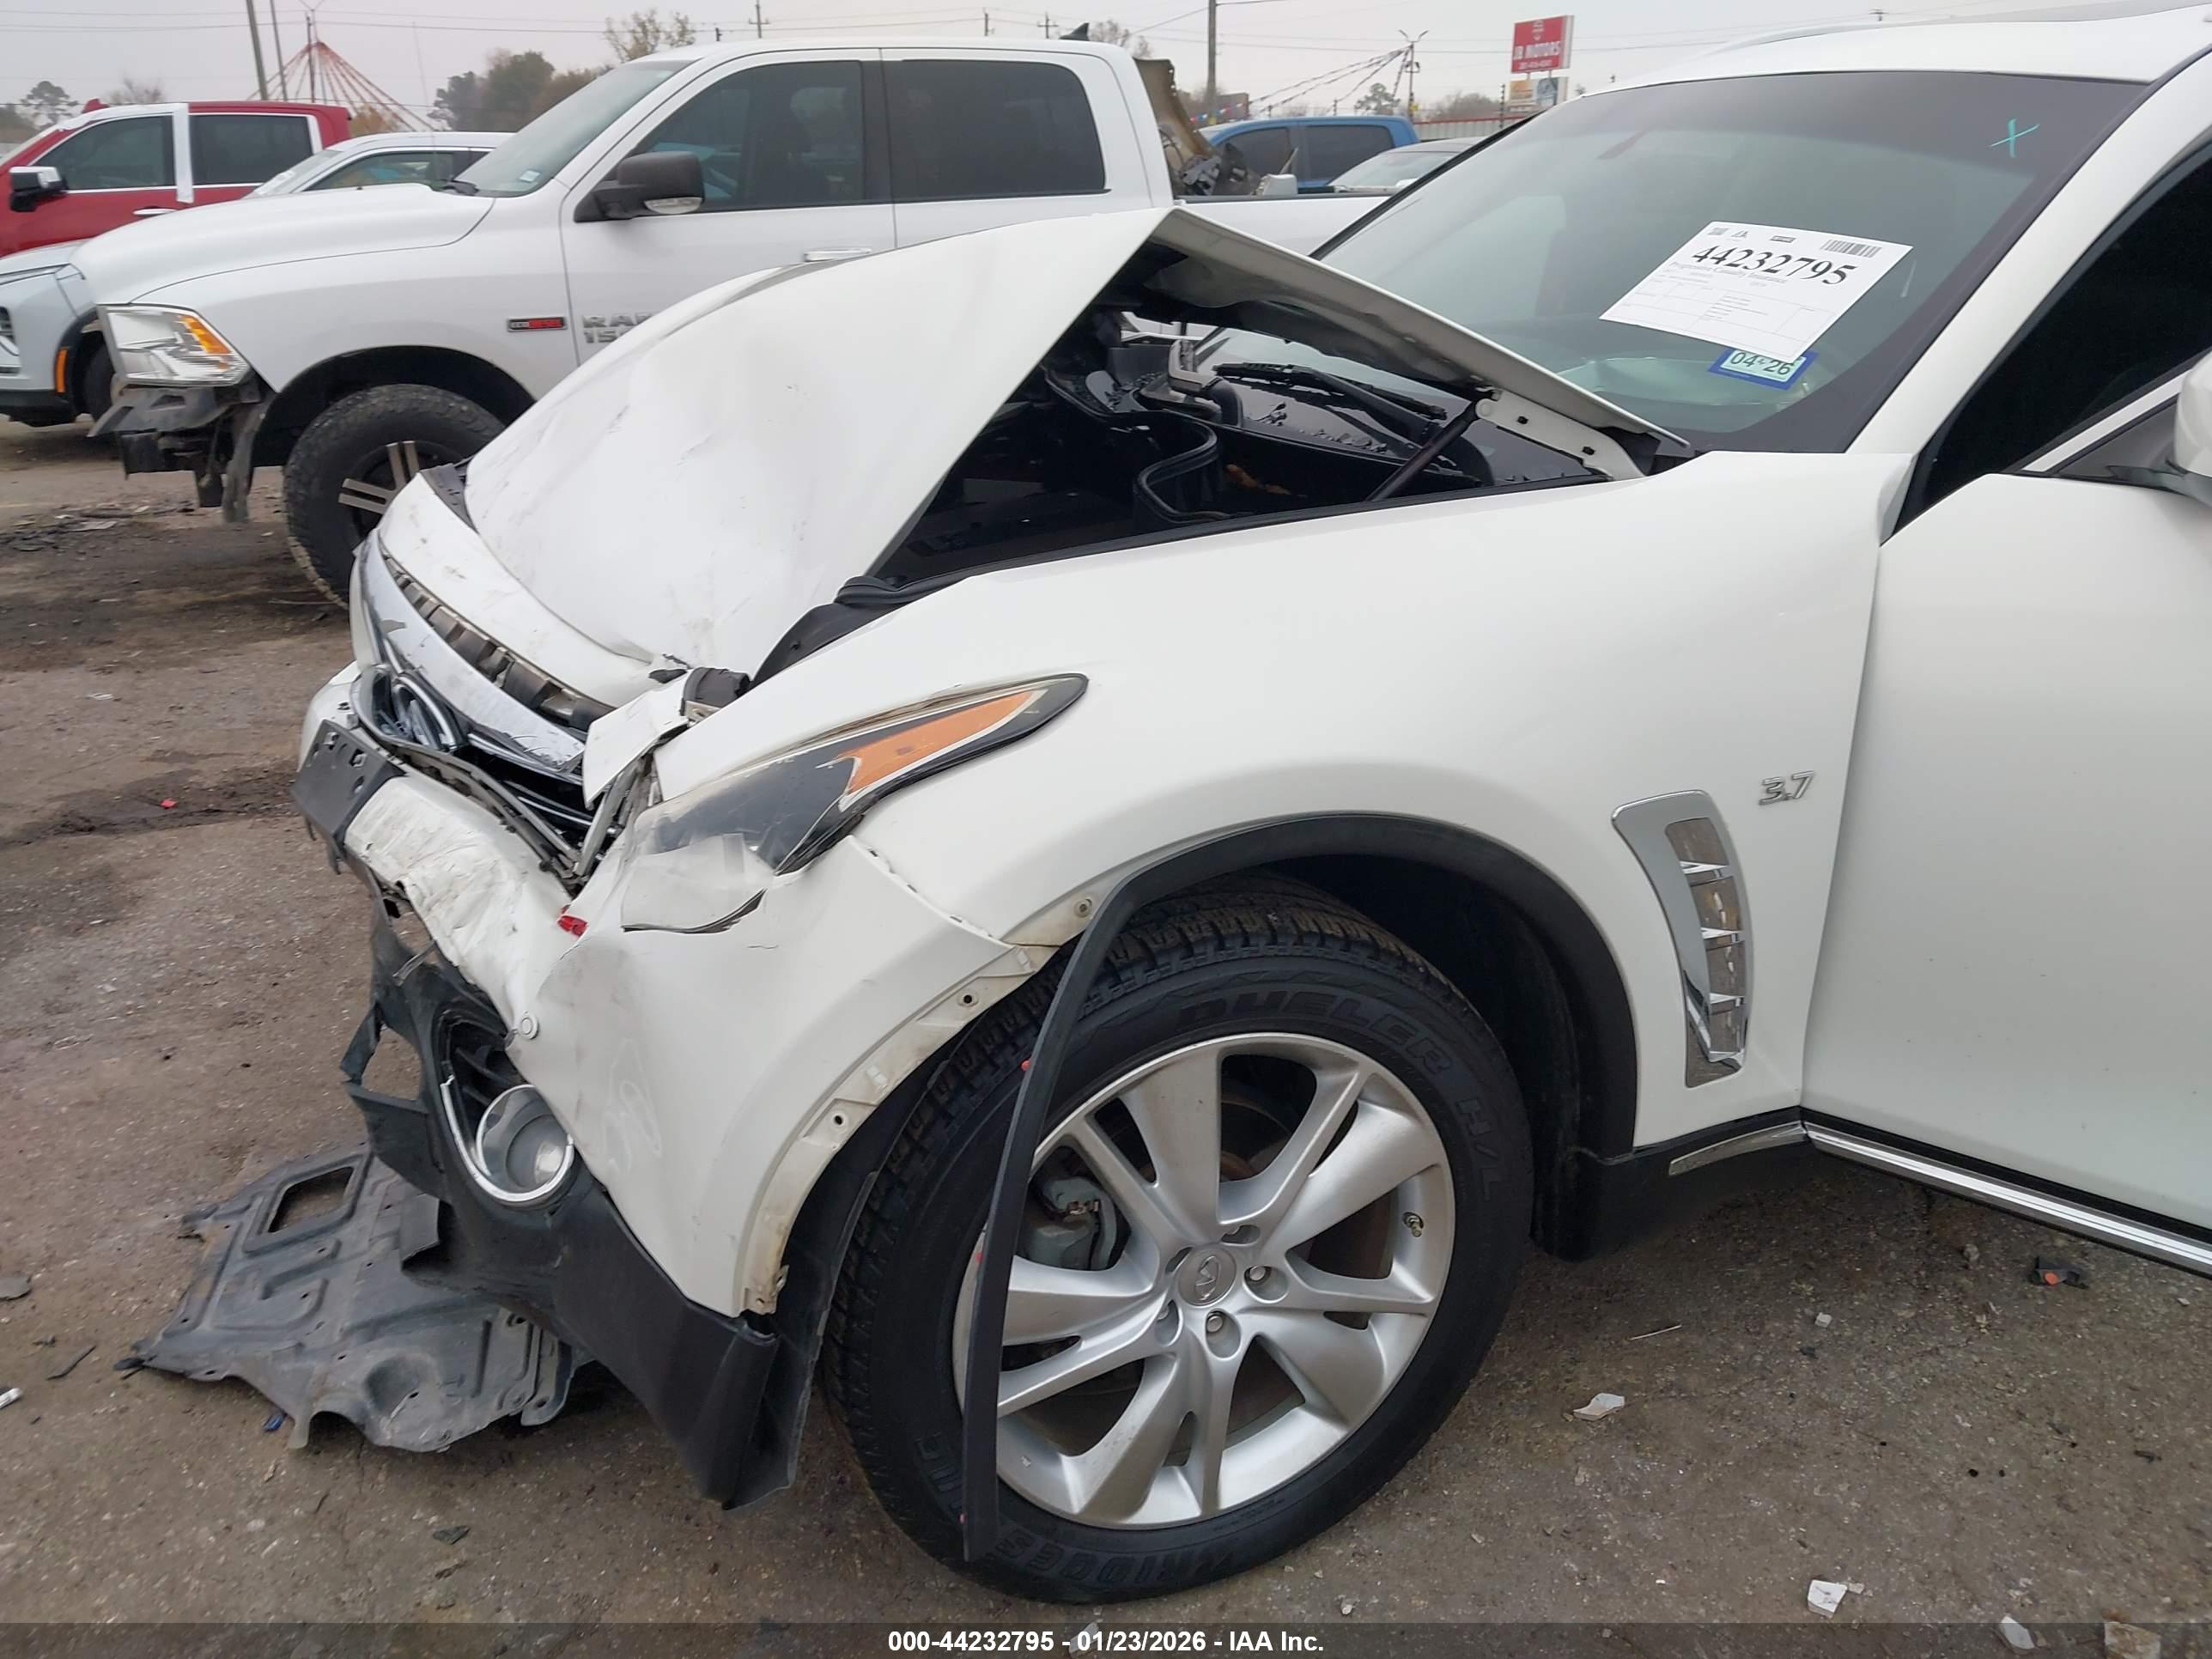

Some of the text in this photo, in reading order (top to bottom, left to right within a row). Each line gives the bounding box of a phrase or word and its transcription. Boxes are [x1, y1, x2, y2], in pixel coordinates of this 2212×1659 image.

[1691, 244, 1860, 286] 44232795
[1729, 351, 1756, 368] 04
[1758, 769, 1814, 806] 3.7
[1177, 988, 1455, 1079] DUELER
